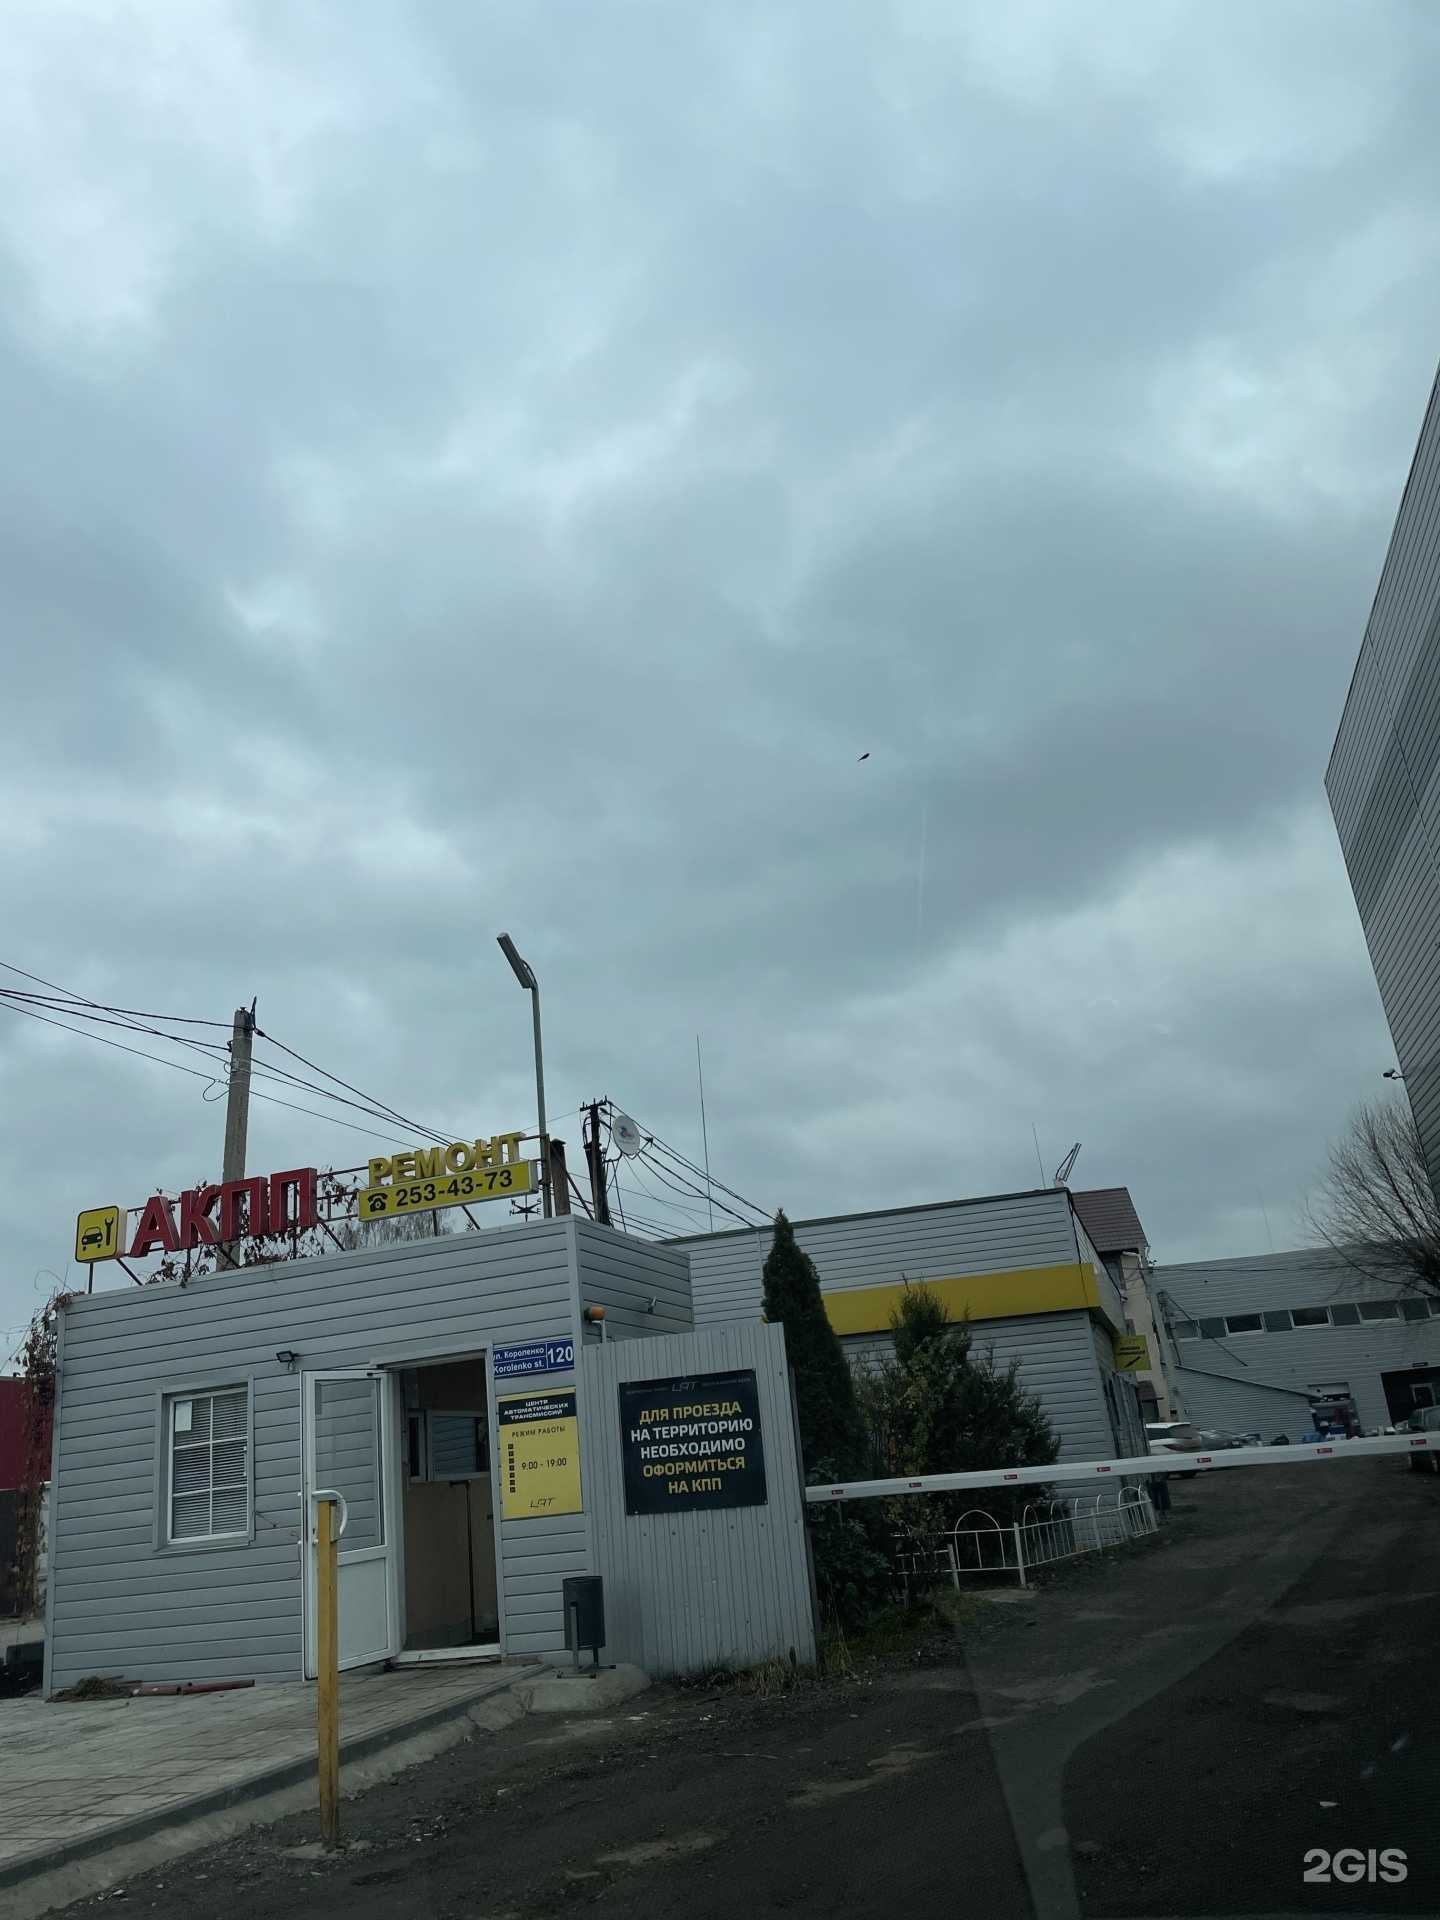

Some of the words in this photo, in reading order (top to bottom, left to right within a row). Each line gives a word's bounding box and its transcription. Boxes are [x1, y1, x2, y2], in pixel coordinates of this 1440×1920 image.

[369, 1132, 525, 1187] РЕМОНТ
[396, 1169, 513, 1207] 253-43-73
[128, 1167, 318, 1258] АКПП
[504, 1348, 544, 1358] Короленко
[548, 1346, 573, 1363] 120
[495, 1363, 532, 1373] Korolenko
[504, 1403, 568, 1415] АВТОМАТИЧЕСКИХ
[525, 1399, 549, 1407] ЦЕНТР
[511, 1410, 562, 1419] ТРАНСМИССИЙ
[639, 1409, 669, 1425] ДЛЯ
[673, 1402, 742, 1419] ПРОЕЗДА
[537, 1425, 566, 1434] РАБОТЫ
[630, 1428, 651, 1443] НА
[652, 1419, 753, 1438] ТЕРРИТОРИЮ
[641, 1438, 745, 1459] НЕОБХОДИМО
[643, 1457, 745, 1477] ОФОРМИТЬСЯ
[668, 1480, 689, 1495] НА
[691, 1477, 722, 1493] КПП
